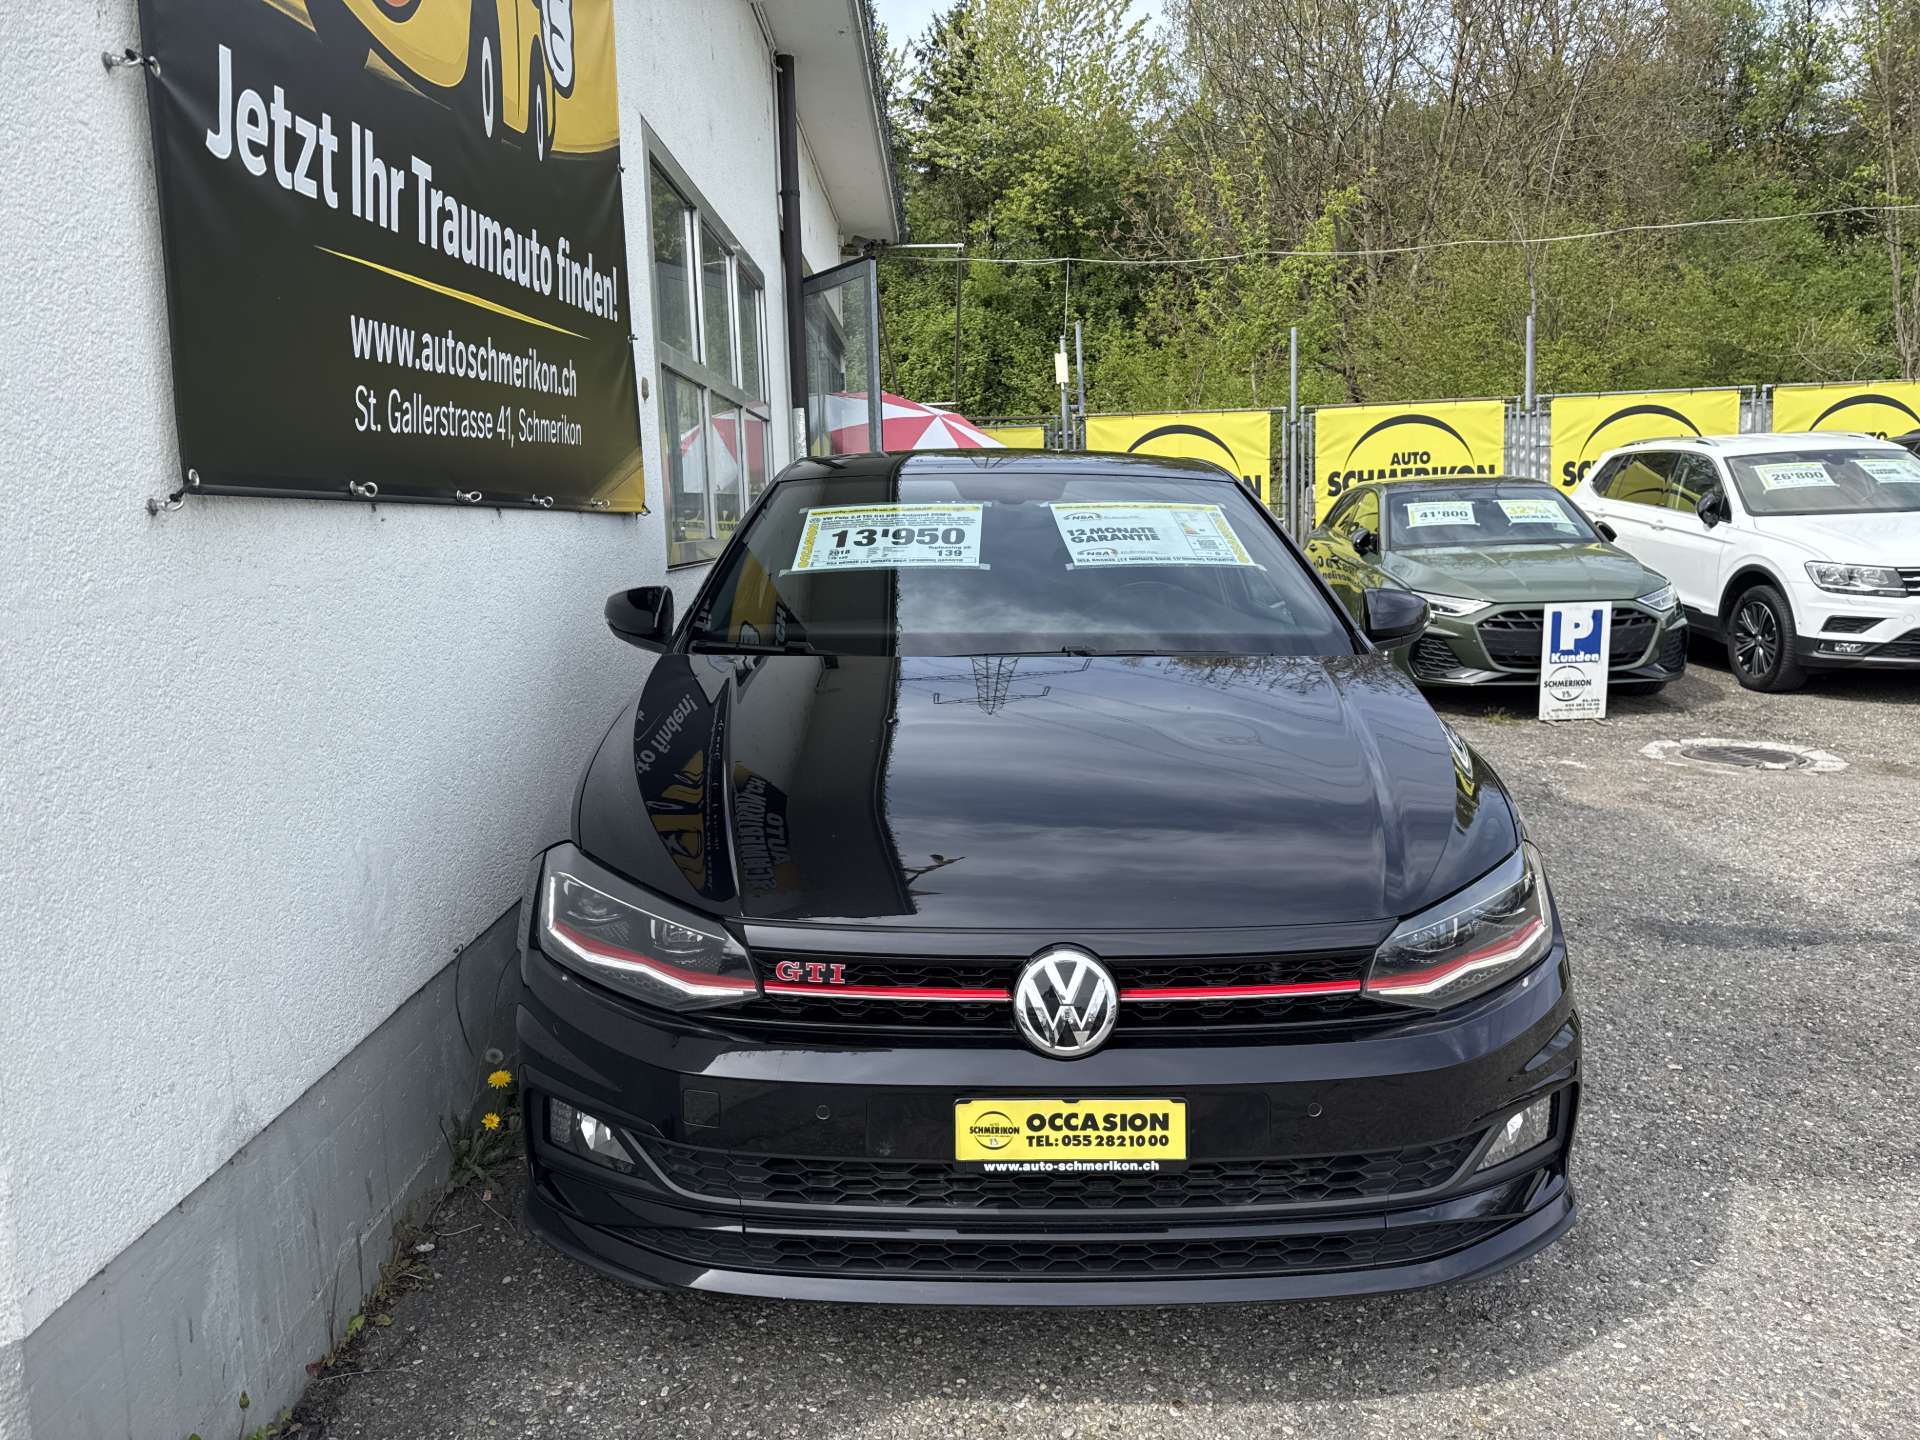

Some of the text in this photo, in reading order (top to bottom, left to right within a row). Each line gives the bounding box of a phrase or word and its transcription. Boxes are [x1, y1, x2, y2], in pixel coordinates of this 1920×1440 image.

[205, 43, 618, 322] Jetzt Ihr Traumauto finden!
[350, 314, 577, 398] www.autoschmerikon.ch
[354, 385, 582, 448] St. Gallerstrasse 41, Schmerikon
[1389, 450, 1431, 466] AUTO
[1771, 471, 1825, 481] 26'800
[1419, 510, 1469, 518] 41'800
[831, 527, 966, 549] 13'950
[1066, 527, 1156, 537] 12 MONATE
[1070, 534, 1160, 544] GARANTIE
[1560, 610, 1594, 651] P
[1550, 651, 1600, 663] Kunden
[1543, 679, 1592, 688] SCHMERIKON
[775, 960, 846, 984] GTI
[1026, 1113, 1170, 1132] OCCASION
[969, 1126, 1020, 1135] SCHMERIKON
[1026, 1135, 1059, 1148] TEL:
[1061, 1135, 1092, 1147] 055
[983, 1161, 1160, 1172] www.auto-schmerikon.ch
